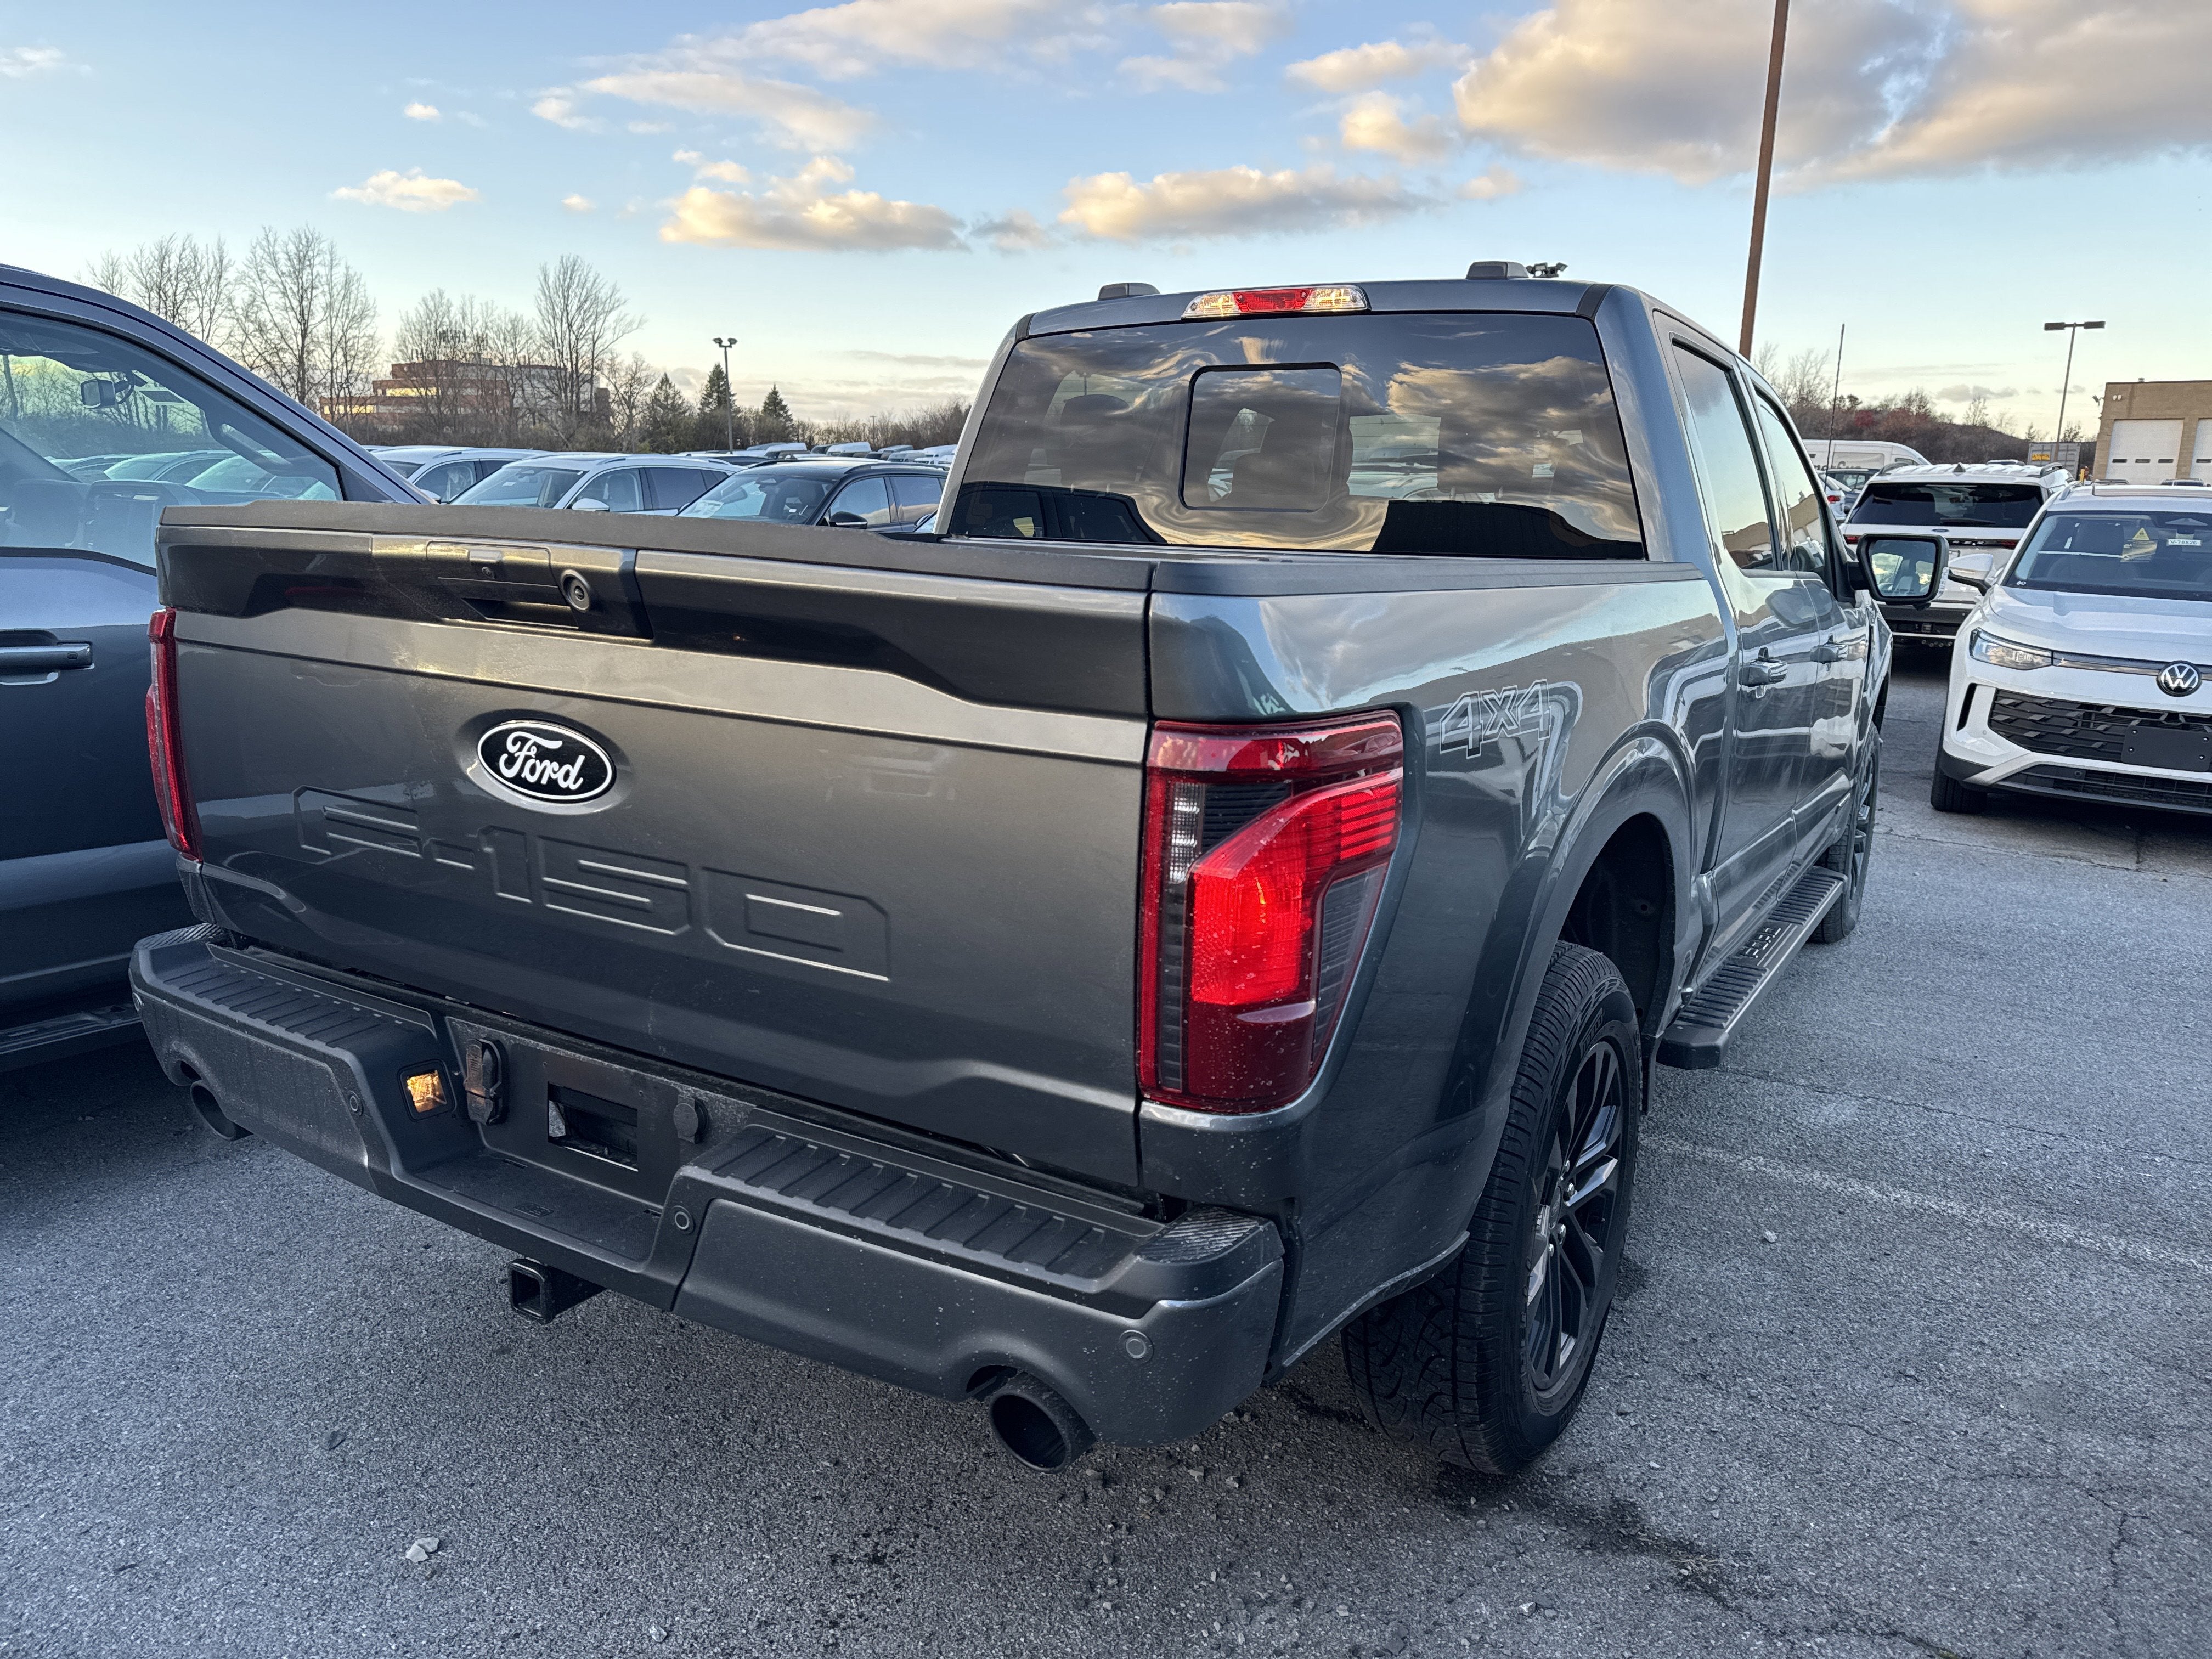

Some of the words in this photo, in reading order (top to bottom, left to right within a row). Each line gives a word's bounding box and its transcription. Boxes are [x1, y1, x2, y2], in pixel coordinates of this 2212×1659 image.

[2160, 663, 2199, 690] VW
[499, 731, 585, 790] Ford
[293, 785, 890, 981] F-150
